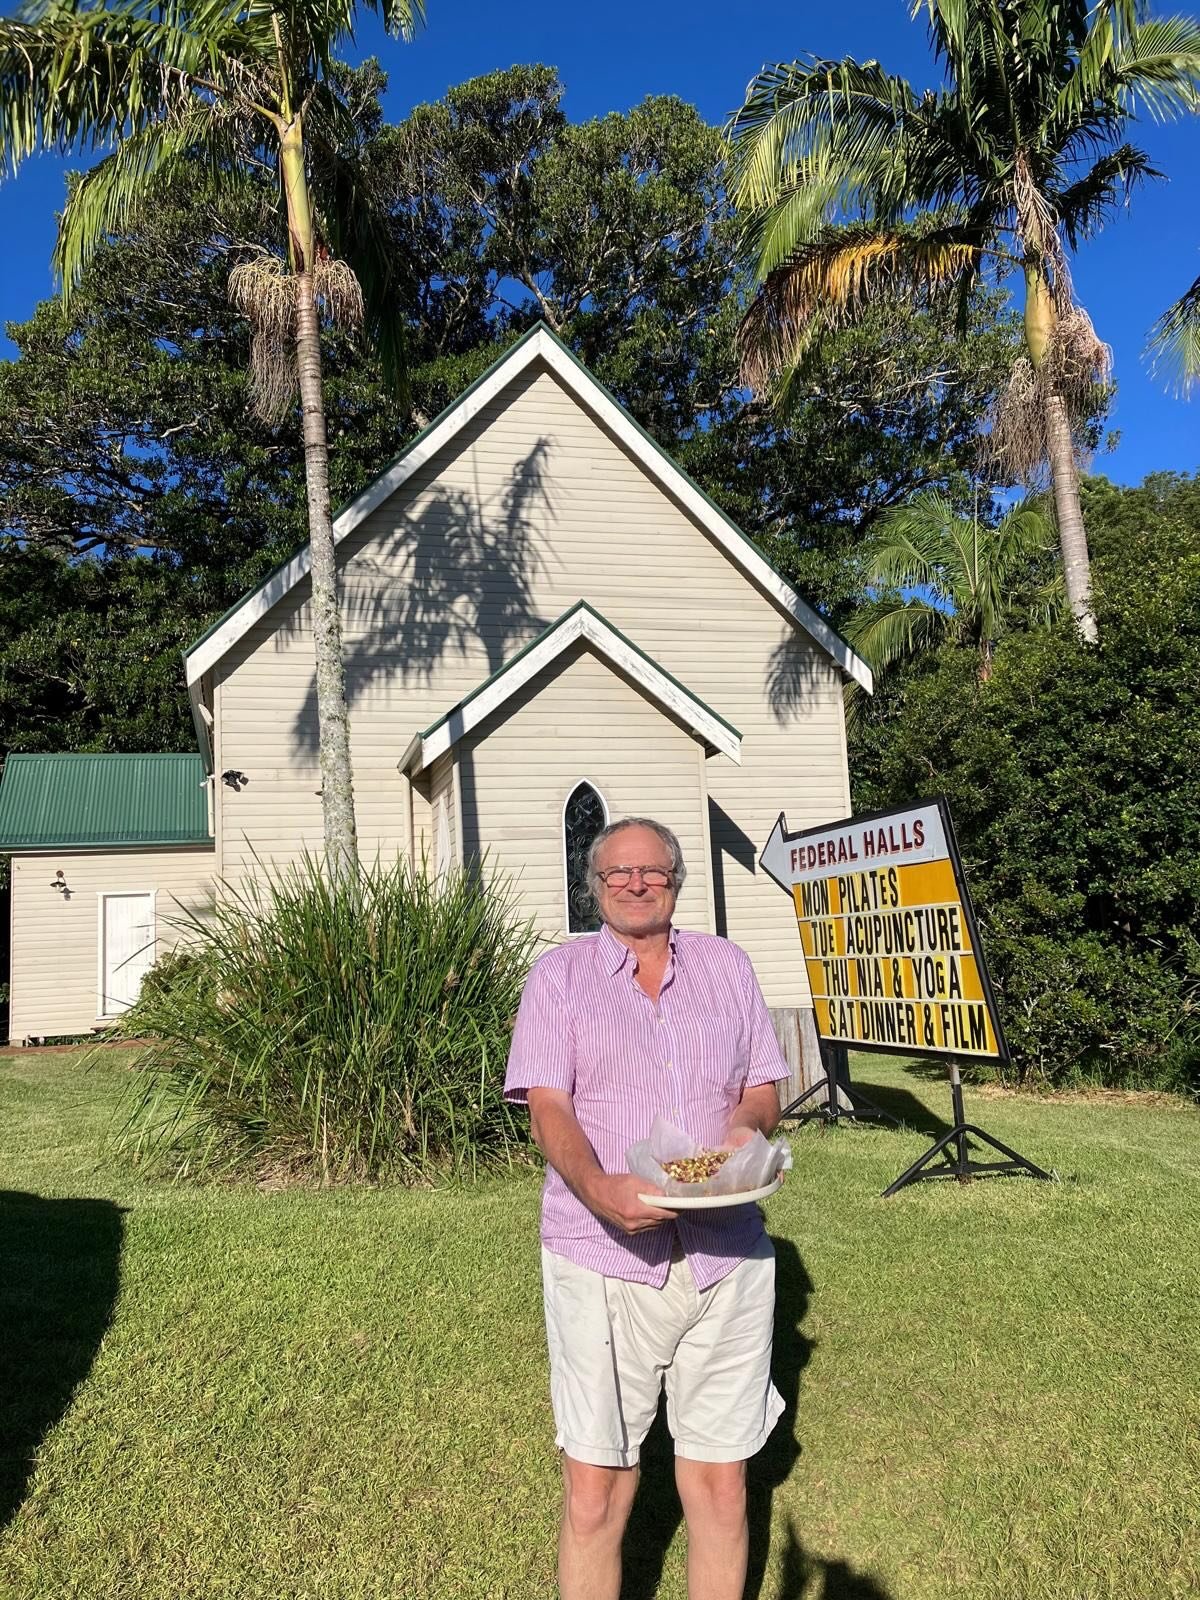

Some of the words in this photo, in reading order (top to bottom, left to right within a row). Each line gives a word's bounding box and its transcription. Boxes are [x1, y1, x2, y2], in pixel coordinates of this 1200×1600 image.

[790, 835, 858, 873] FEDERAL
[863, 819, 925, 857] HALLS
[801, 879, 829, 917] MON
[838, 866, 898, 913] PILATES
[811, 921, 835, 956] TUE
[847, 907, 961, 955] ACUPUNCTURE
[823, 960, 849, 997] THU
[856, 958, 883, 997] NIA
[892, 958, 903, 998] &
[912, 955, 962, 999] YOGA
[829, 1001, 854, 1039] SAT
[860, 1002, 917, 1045] DINNER
[923, 1006, 934, 1046] &
[942, 1004, 988, 1050] FILM
